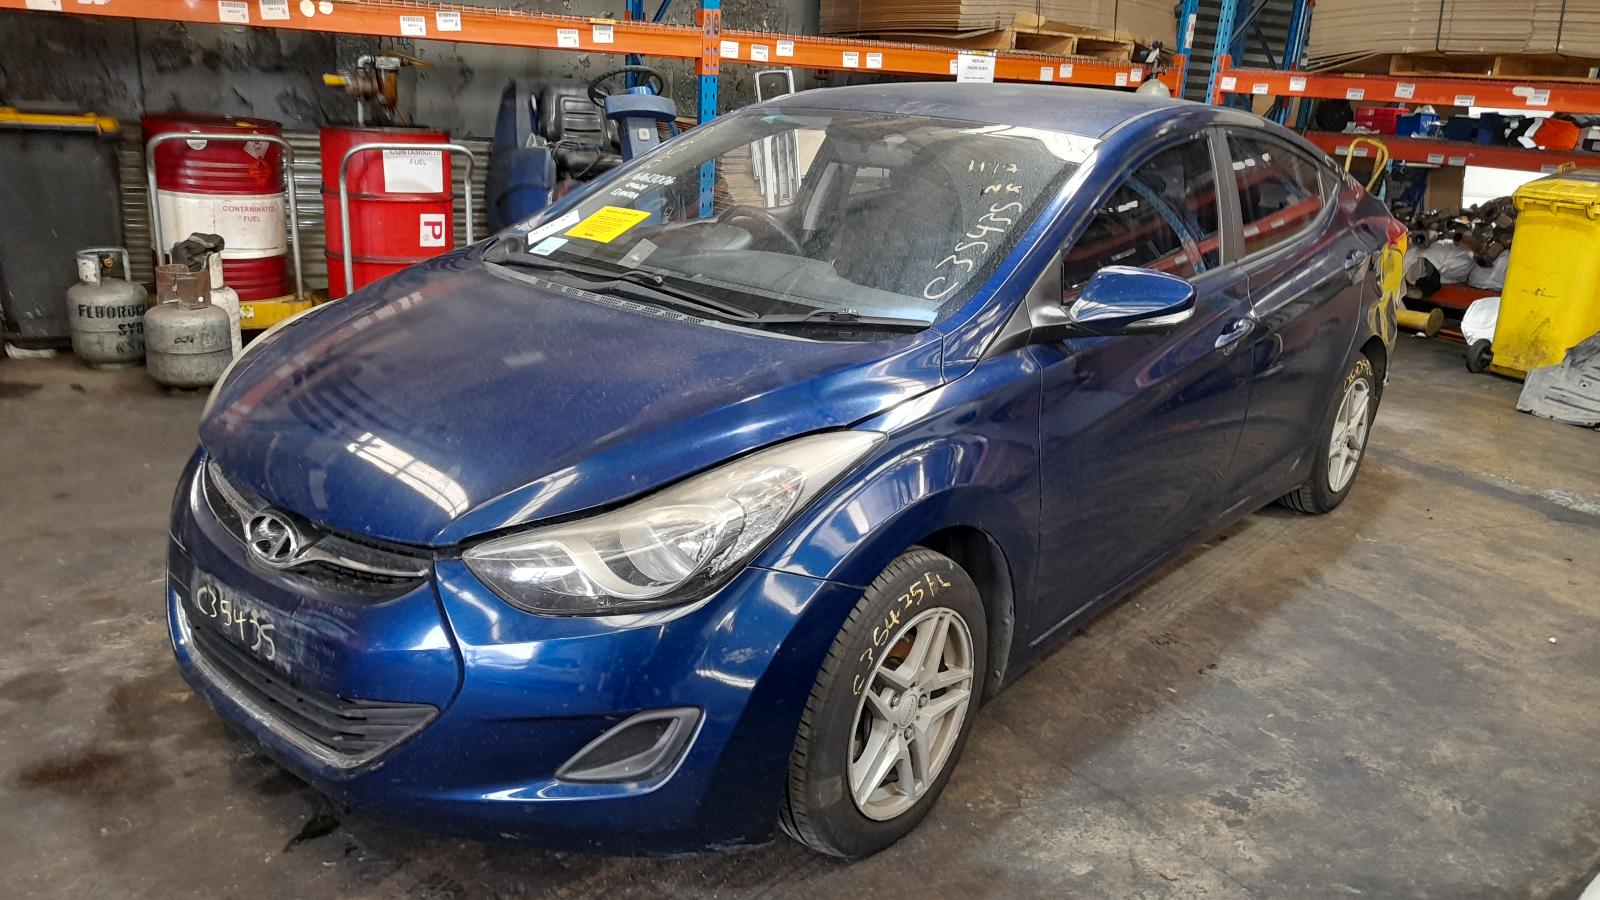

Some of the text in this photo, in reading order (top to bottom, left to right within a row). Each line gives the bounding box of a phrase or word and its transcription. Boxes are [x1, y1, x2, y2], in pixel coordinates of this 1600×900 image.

[409, 158, 427, 166] FUEL
[222, 205, 276, 213] CONTAMINATED
[243, 215, 262, 223] FUEL
[197, 586, 276, 661] C35435
